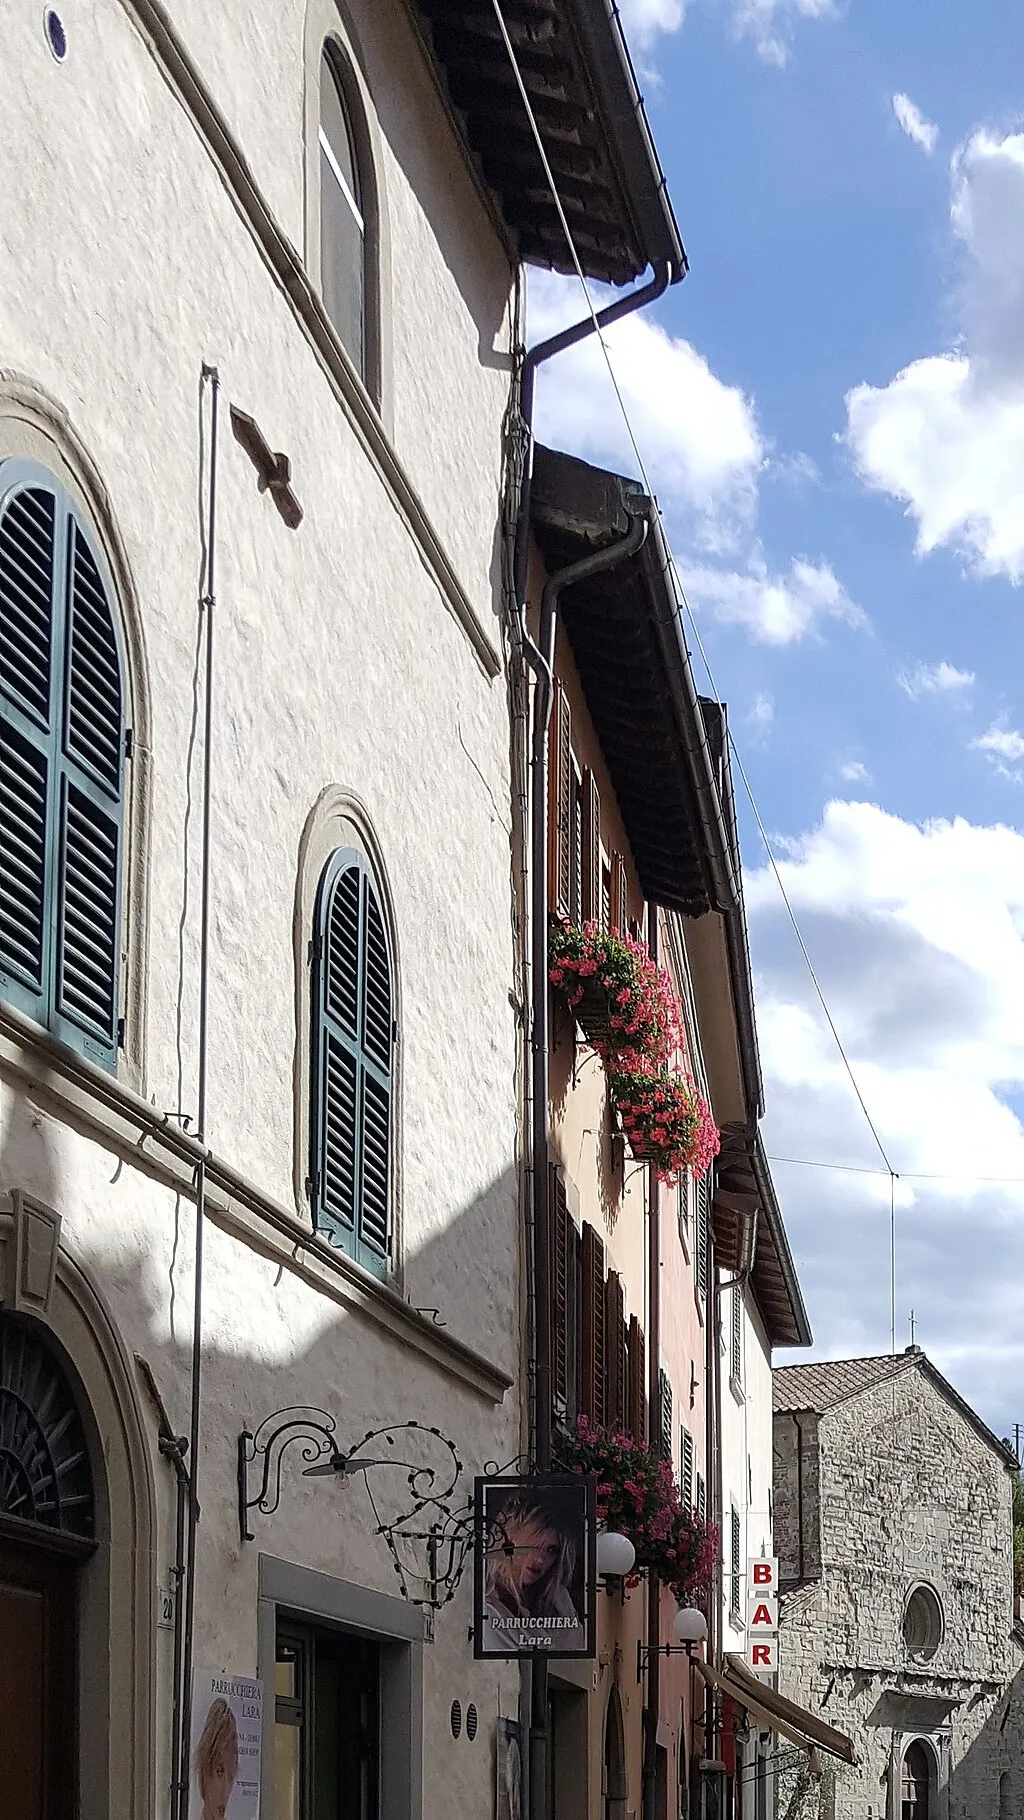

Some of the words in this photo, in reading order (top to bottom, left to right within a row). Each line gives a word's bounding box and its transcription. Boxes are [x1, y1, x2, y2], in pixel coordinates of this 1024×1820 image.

[163, 1597, 173, 1620] 20
[752, 1564, 772, 1665] BAR
[491, 1616, 579, 1629] PARRUCCHIERA
[518, 1634, 552, 1646] Lara
[211, 1678, 261, 1700] PARRUCCHIERA
[242, 1704, 261, 1719] LARA
